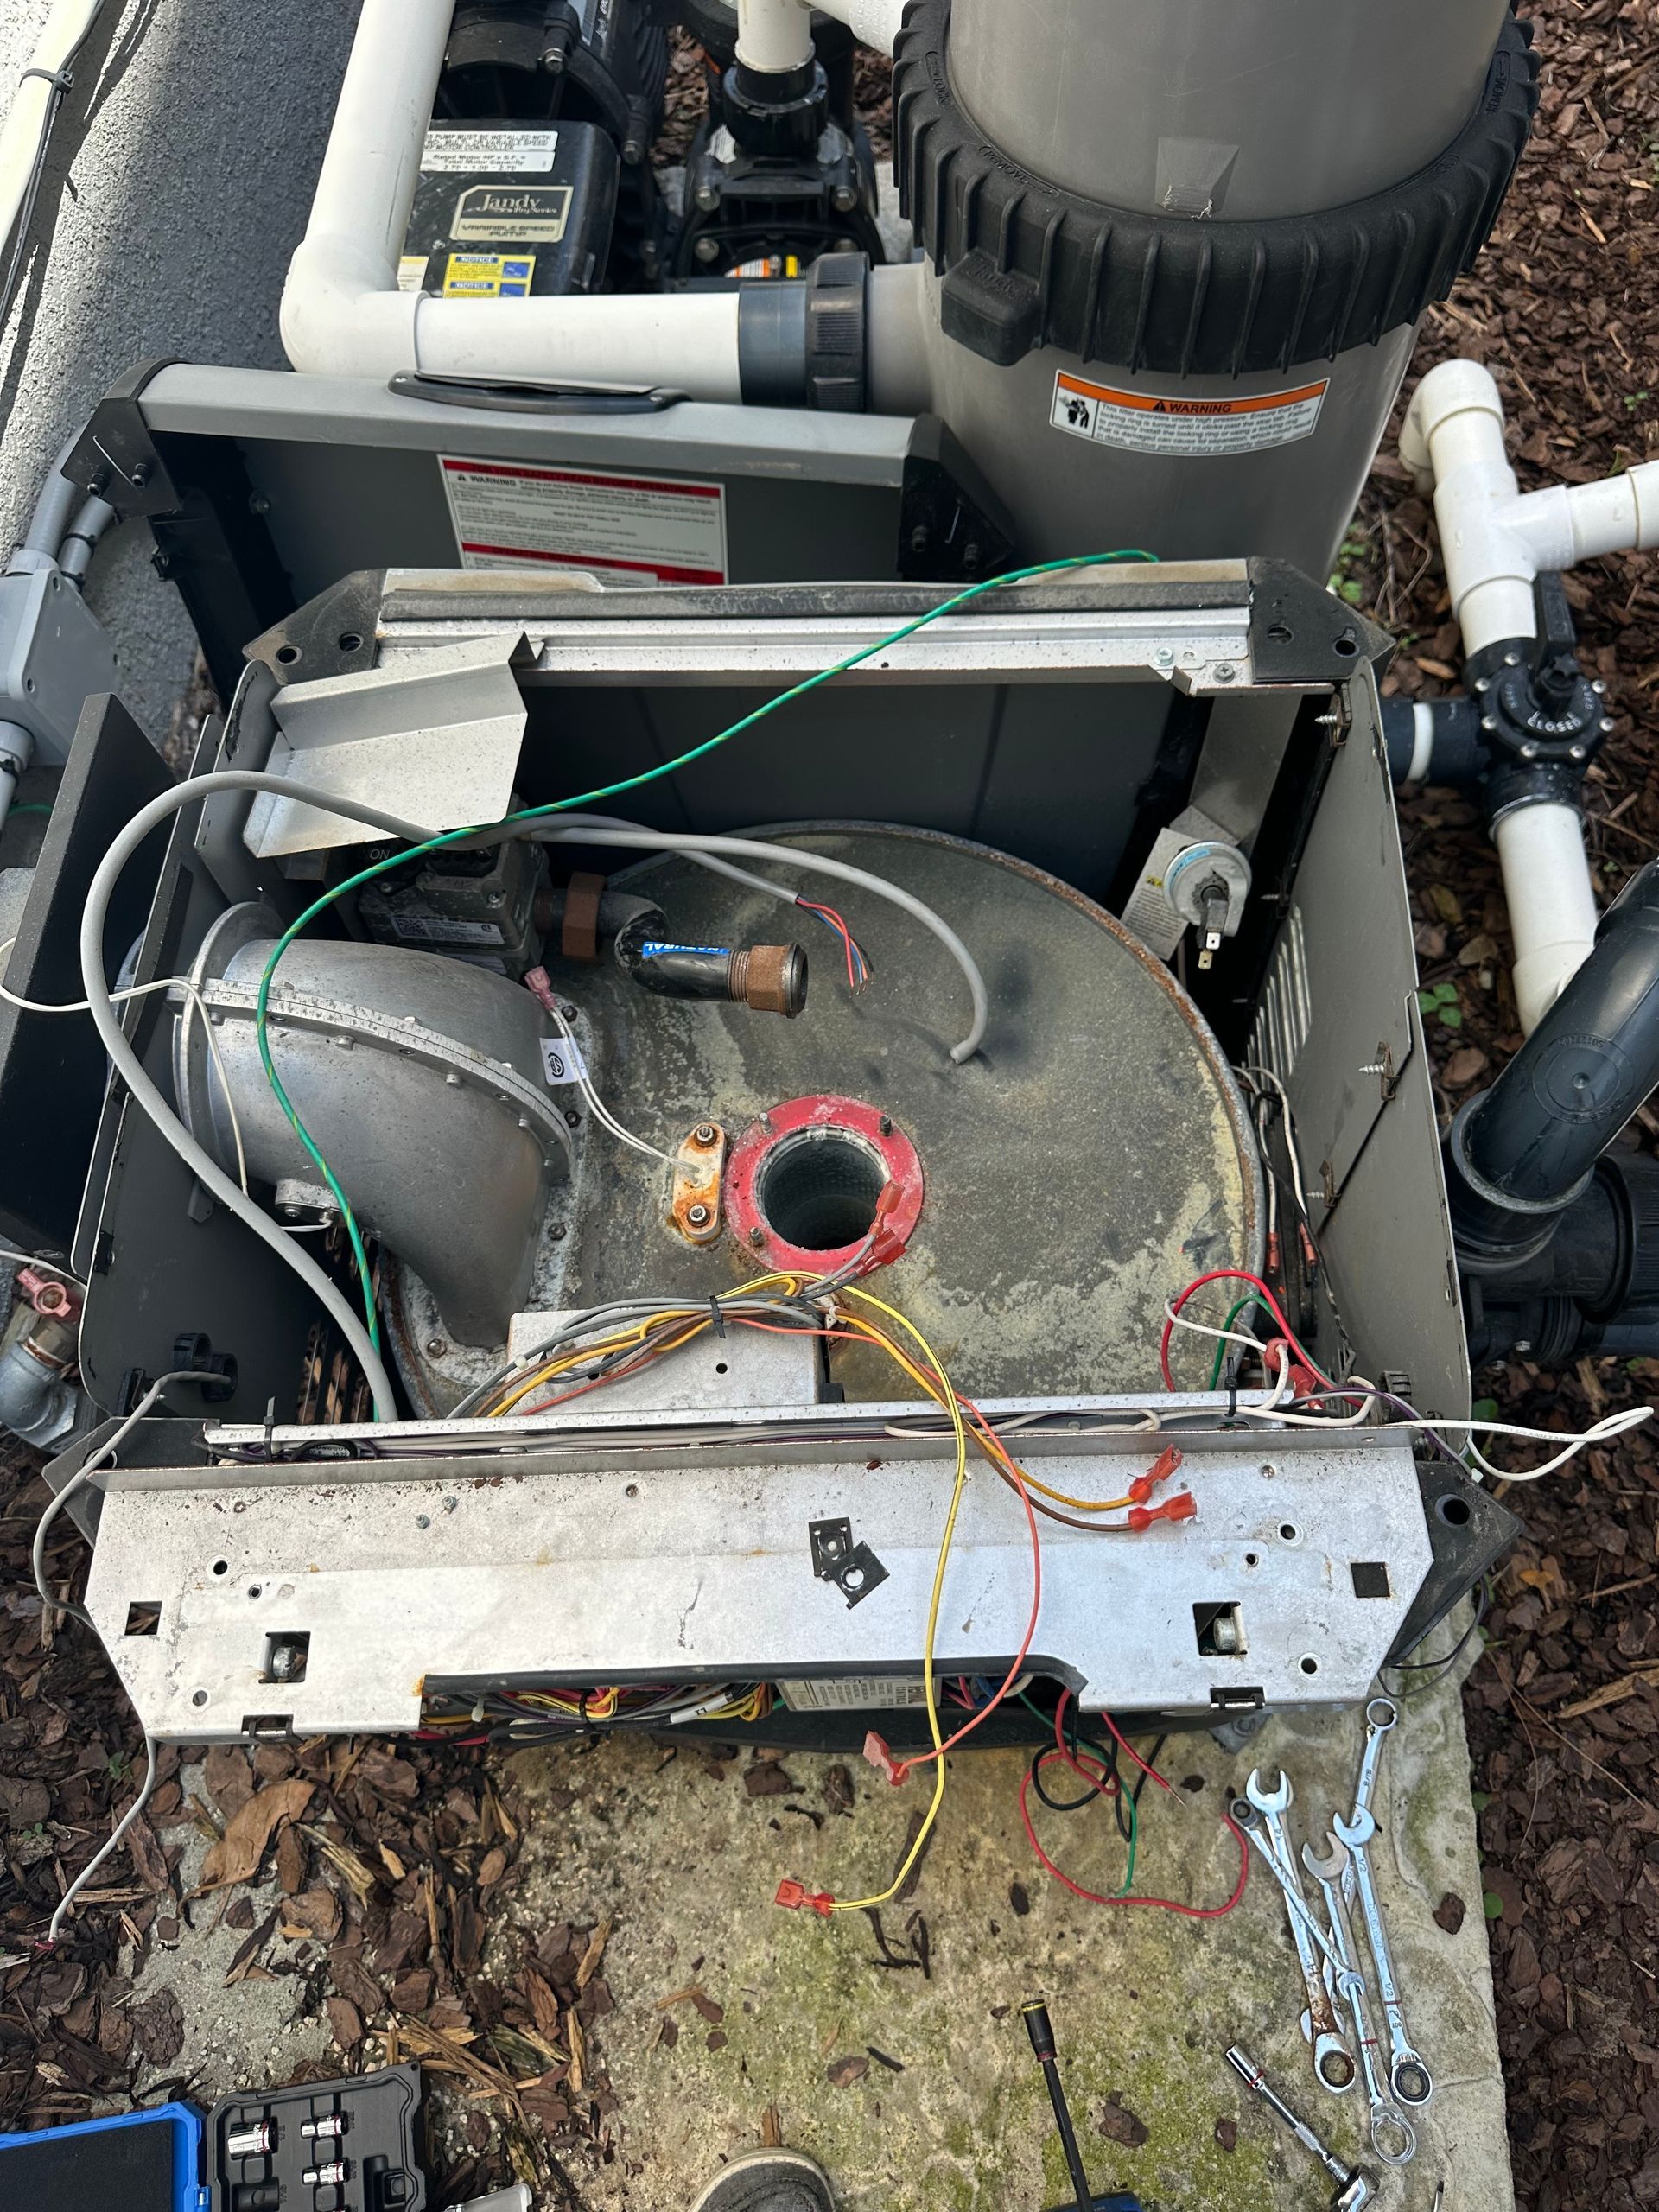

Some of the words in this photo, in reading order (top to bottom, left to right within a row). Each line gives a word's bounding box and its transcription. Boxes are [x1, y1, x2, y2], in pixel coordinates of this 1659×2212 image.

[478, 194, 542, 212] Jandy
[1102, 404, 1117, 413] This
[1136, 411, 1169, 423] operates
[1249, 410, 1276, 420] Ensure
[1169, 403, 1232, 414] WARNING
[1099, 411, 1125, 423] locking
[1127, 416, 1142, 426] ring
[1152, 421, 1176, 429] turned
[1224, 422, 1241, 431] past
[1255, 418, 1272, 428] stop
[1287, 407, 1312, 419] Failure
[1107, 420, 1138, 432] properly
[1140, 425, 1160, 435] install
[1176, 430, 1203, 440] locking
[1205, 431, 1219, 440] ring
[1230, 428, 1250, 437] using
[1258, 423, 1283, 434] locking
[1284, 418, 1299, 428] ring
[1121, 429, 1156, 442] damaged
[1249, 431, 1271, 441] which
[1272, 426, 1292, 435] could
[1293, 419, 1312, 430] result
[1128, 440, 1156, 449] serious
[1158, 443, 1190, 452] personal
[1192, 444, 1212, 454] injury
[1223, 442, 1253, 453] property
[469, 475, 517, 487] WARNING
[1526, 716, 1584, 734] CLOSED
[369, 849, 391, 860] ON
[695, 1707, 708, 1716] L1
[1359, 1858, 1368, 1873] 1/2
[1367, 1904, 1384, 1951] KOBALT
[1384, 1981, 1394, 1998] 1/2
